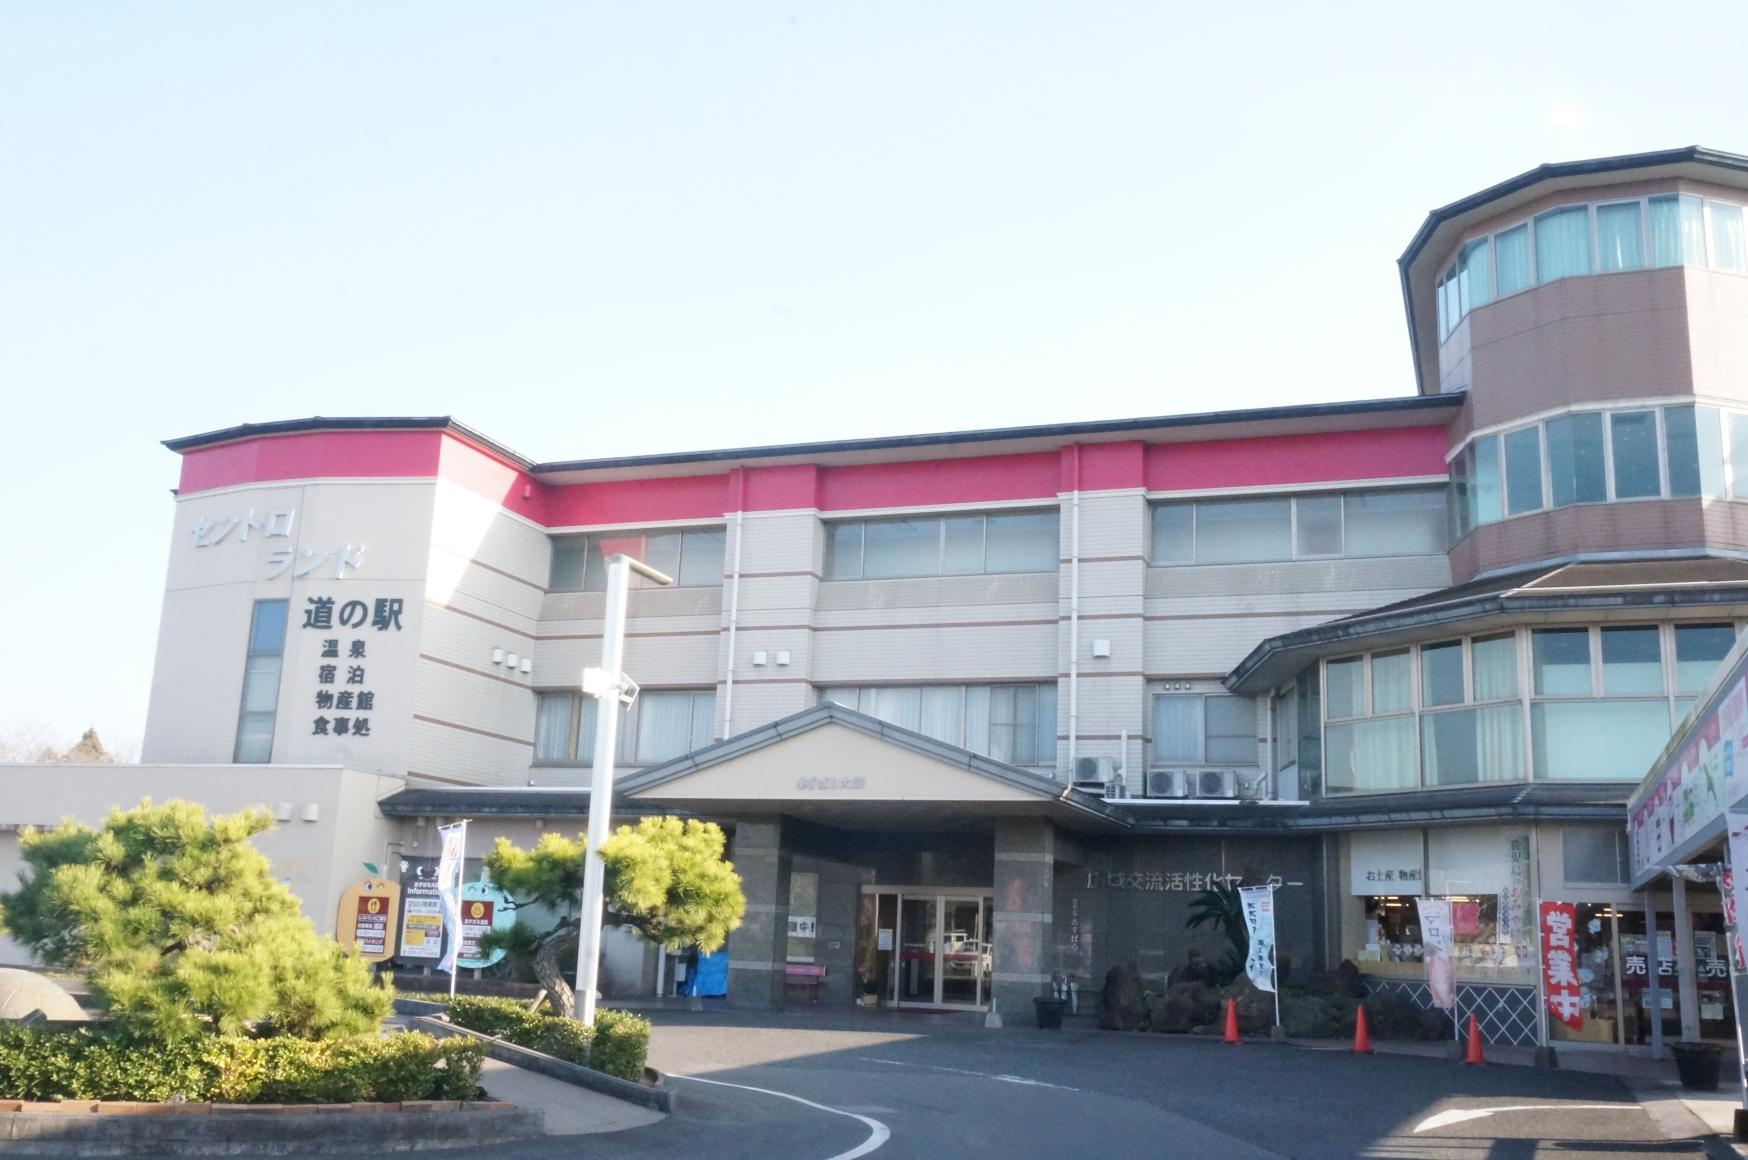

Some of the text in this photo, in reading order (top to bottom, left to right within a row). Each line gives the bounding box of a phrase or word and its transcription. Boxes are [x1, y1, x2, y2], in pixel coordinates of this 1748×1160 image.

[191, 508, 296, 548] セントロ
[266, 543, 366, 580] ランド
[302, 596, 404, 631] 道の駅
[320, 639, 367, 659] 温泉
[318, 664, 365, 684] 宿泊
[315, 690, 375, 711] 物産館
[311, 716, 371, 736] 食事処
[1087, 872, 1304, 892] 域交流活性化セター
[1366, 869, 1422, 881] お土産 物産
[1546, 911, 1579, 1022] 営業中
